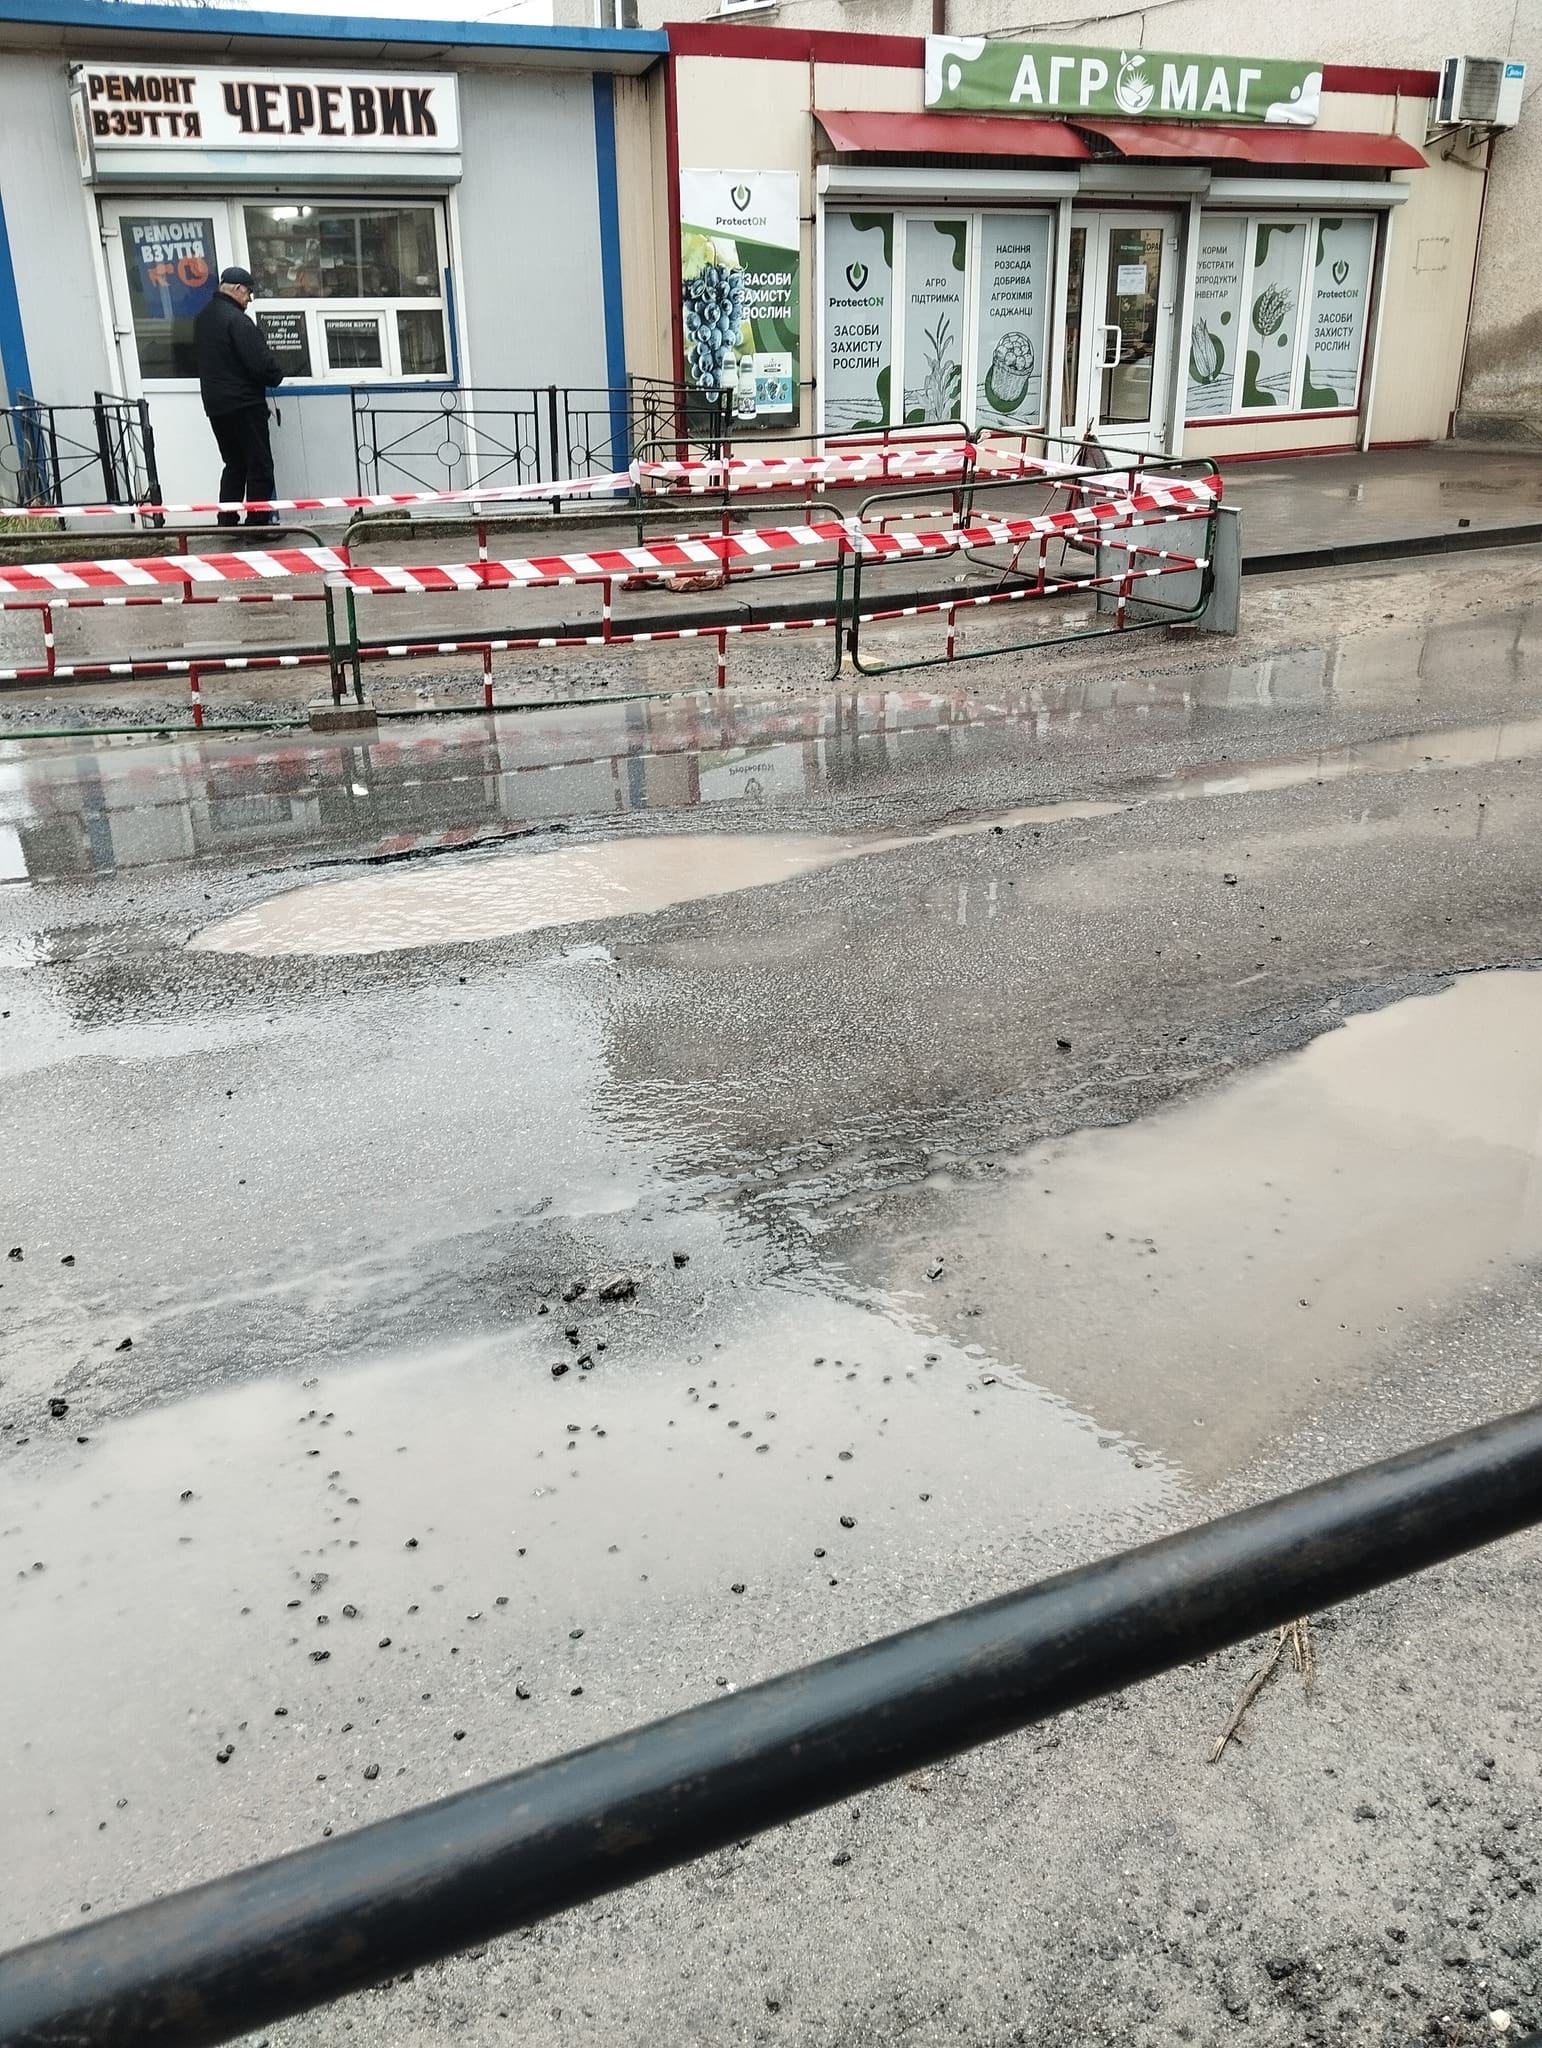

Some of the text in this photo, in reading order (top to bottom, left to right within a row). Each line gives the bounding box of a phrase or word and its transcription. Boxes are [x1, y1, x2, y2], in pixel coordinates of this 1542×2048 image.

[88, 74, 197, 104] РЕМОНТ
[220, 81, 438, 137] ЧЕРЕВИК
[92, 109, 202, 139] ВЗУТТЯ
[715, 216, 767, 226] ProtectON
[132, 223, 204, 244] РЕМОНТ
[141, 241, 205, 263] ВЗУТТЯ
[996, 245, 1031, 254] НАСІННЯ
[1202, 246, 1228, 255] КОРМИ
[994, 260, 1032, 270] РОЗСАДА
[1196, 261, 1234, 270] УБСТРАТИ
[744, 272, 792, 287] ЗАСОБИ
[925, 278, 947, 288] АГРО
[993, 276, 1031, 287] ДОБРИВА
[738, 289, 792, 304] ЗАХИСТУ
[911, 293, 960, 305] ПІДТРИМКА
[991, 291, 1033, 302] АГРОХІМІЯ
[1317, 289, 1359, 299] ProtectON
[829, 297, 884, 308] ProtectON
[743, 305, 792, 320] РОСЛИН
[989, 307, 1033, 318] САДЖАНЦІ
[1318, 312, 1353, 324] ЗАСОБИ
[834, 325, 880, 338] ЗАСОБИ
[1314, 327, 1354, 339] ЗАХИСТУ
[830, 340, 883, 354] ЗАХИСТУ
[1314, 341, 1351, 352] РОСЛИН
[833, 357, 880, 370] РОСЛИН
